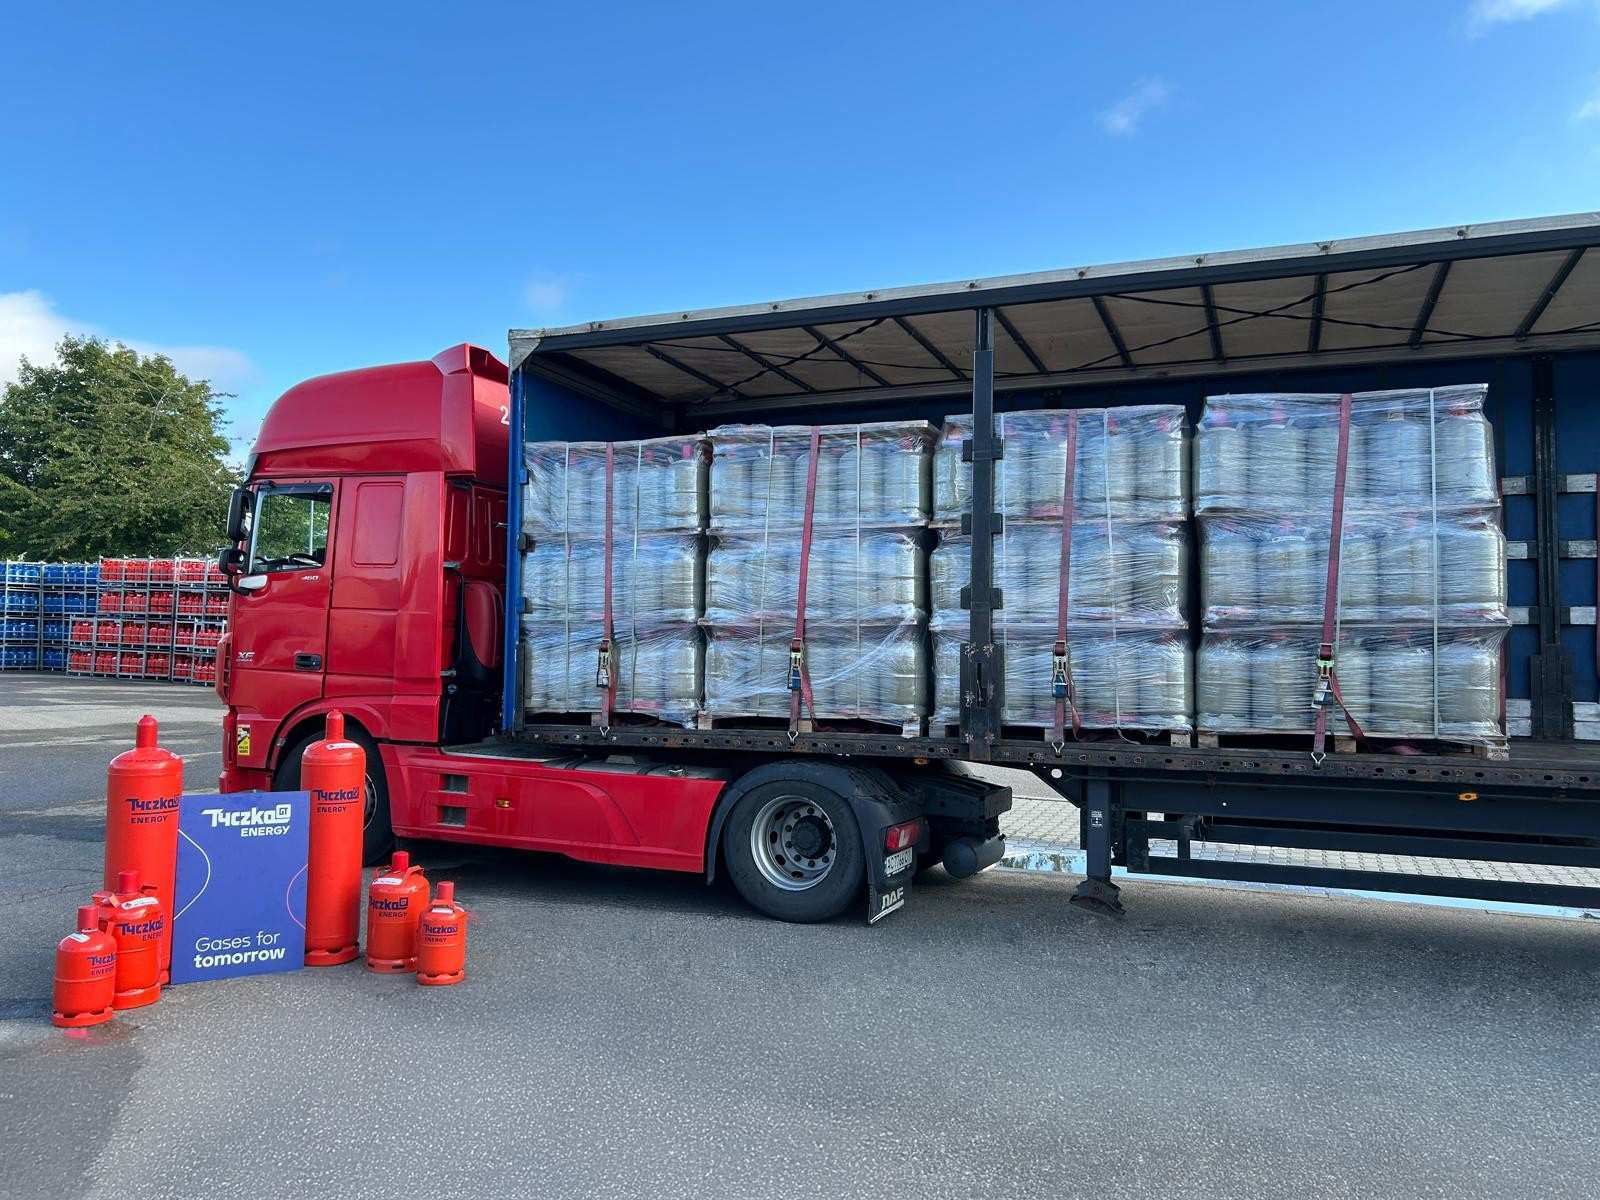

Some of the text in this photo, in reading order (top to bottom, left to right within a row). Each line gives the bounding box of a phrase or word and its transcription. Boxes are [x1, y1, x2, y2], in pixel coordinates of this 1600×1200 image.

[500, 405, 510, 425] 2
[130, 816, 168, 824] ENERGY
[202, 805, 291, 828] Tyczka
[240, 825, 290, 837] ENERGY
[881, 886, 904, 910] DAF
[195, 930, 281, 952] Gases for
[193, 947, 286, 968] tomorrow
